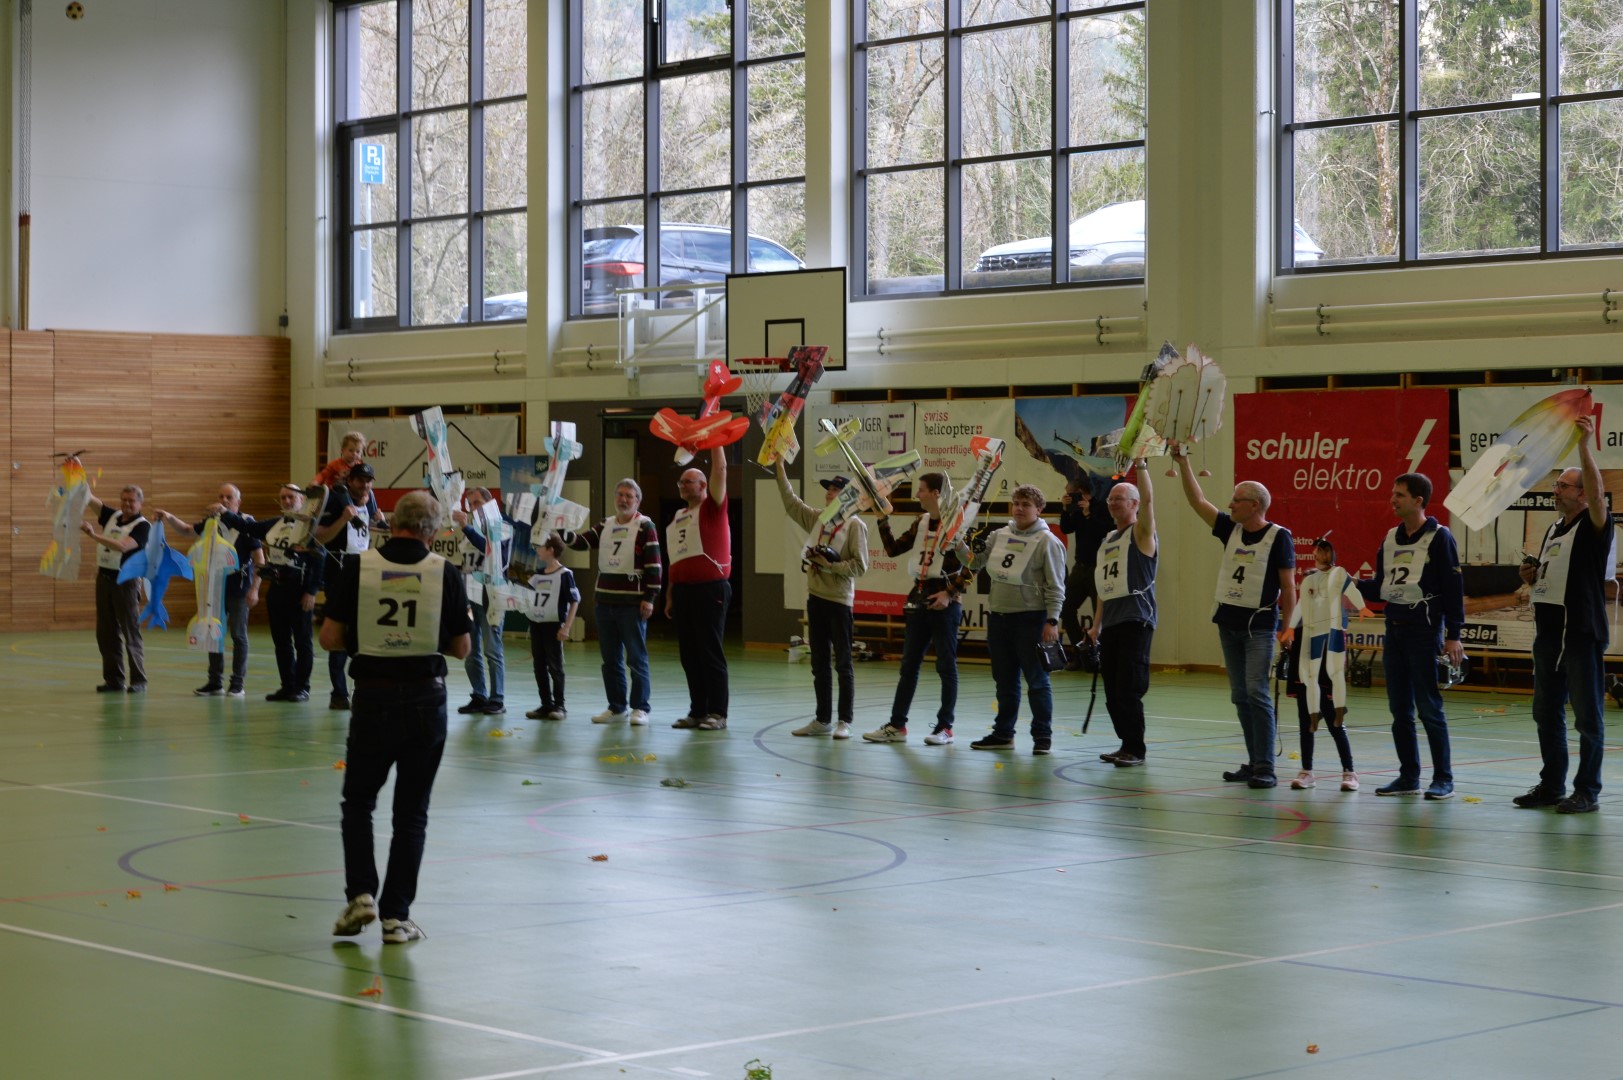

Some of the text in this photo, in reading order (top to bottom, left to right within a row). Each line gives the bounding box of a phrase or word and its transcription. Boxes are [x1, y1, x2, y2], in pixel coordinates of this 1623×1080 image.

[924, 410, 949, 422] swiss
[924, 423, 975, 438] helicopter
[853, 437, 883, 451] GmbH
[1246, 432, 1350, 460] schuler
[467, 470, 487, 480] GmbH
[1293, 462, 1382, 490] elektro
[678, 529, 686, 544] 3
[613, 541, 622, 556] 7
[1001, 553, 1016, 569] 8
[1103, 561, 1119, 580] 14
[1232, 565, 1245, 584] 4
[1389, 567, 1410, 586] 12
[534, 592, 550, 607] 17
[377, 597, 417, 628] 21
